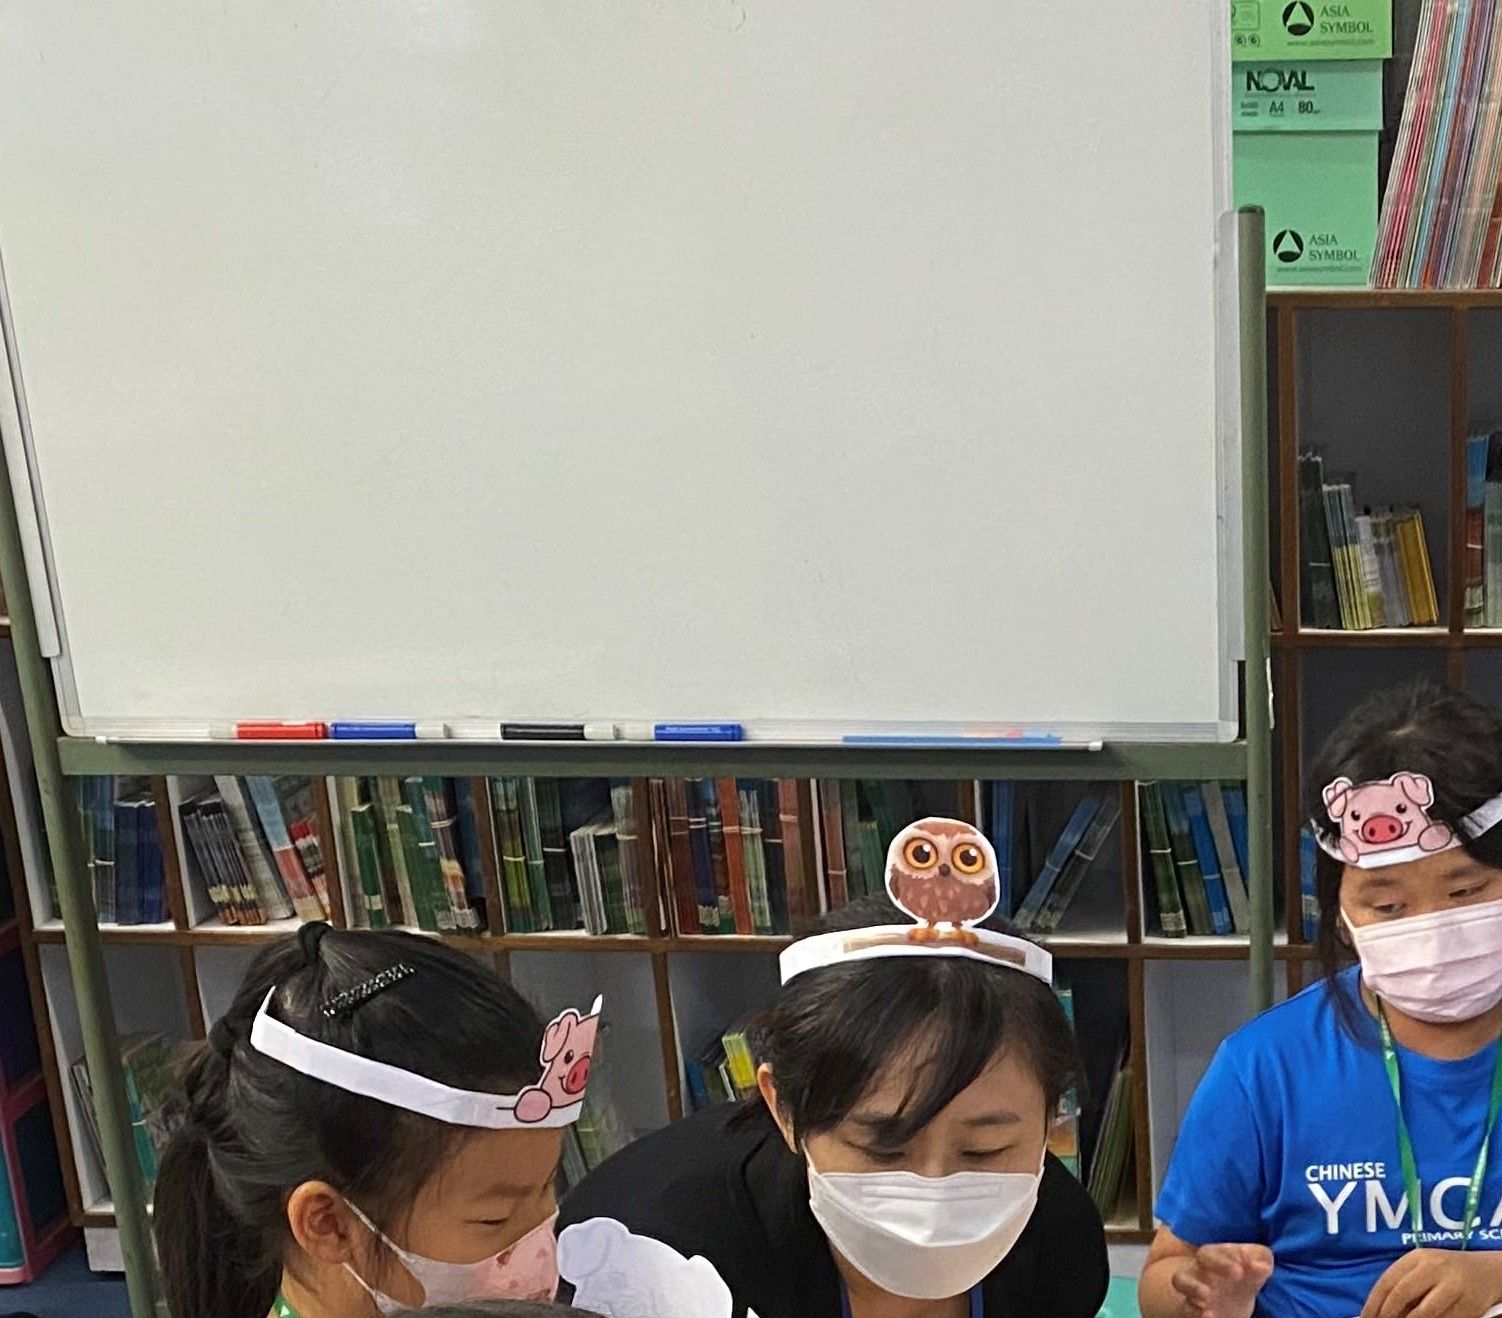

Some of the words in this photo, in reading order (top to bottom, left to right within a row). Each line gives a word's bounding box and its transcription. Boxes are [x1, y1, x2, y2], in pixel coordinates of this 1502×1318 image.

[1320, 5, 1350, 17] ASIA
[1319, 21, 1374, 34] SYMBOL
[1246, 68, 1315, 92] NOVAL
[1309, 234, 1338, 246] ASIA
[1309, 249, 1361, 262] SYMBOL
[1305, 1162, 1386, 1182] CHINESE
